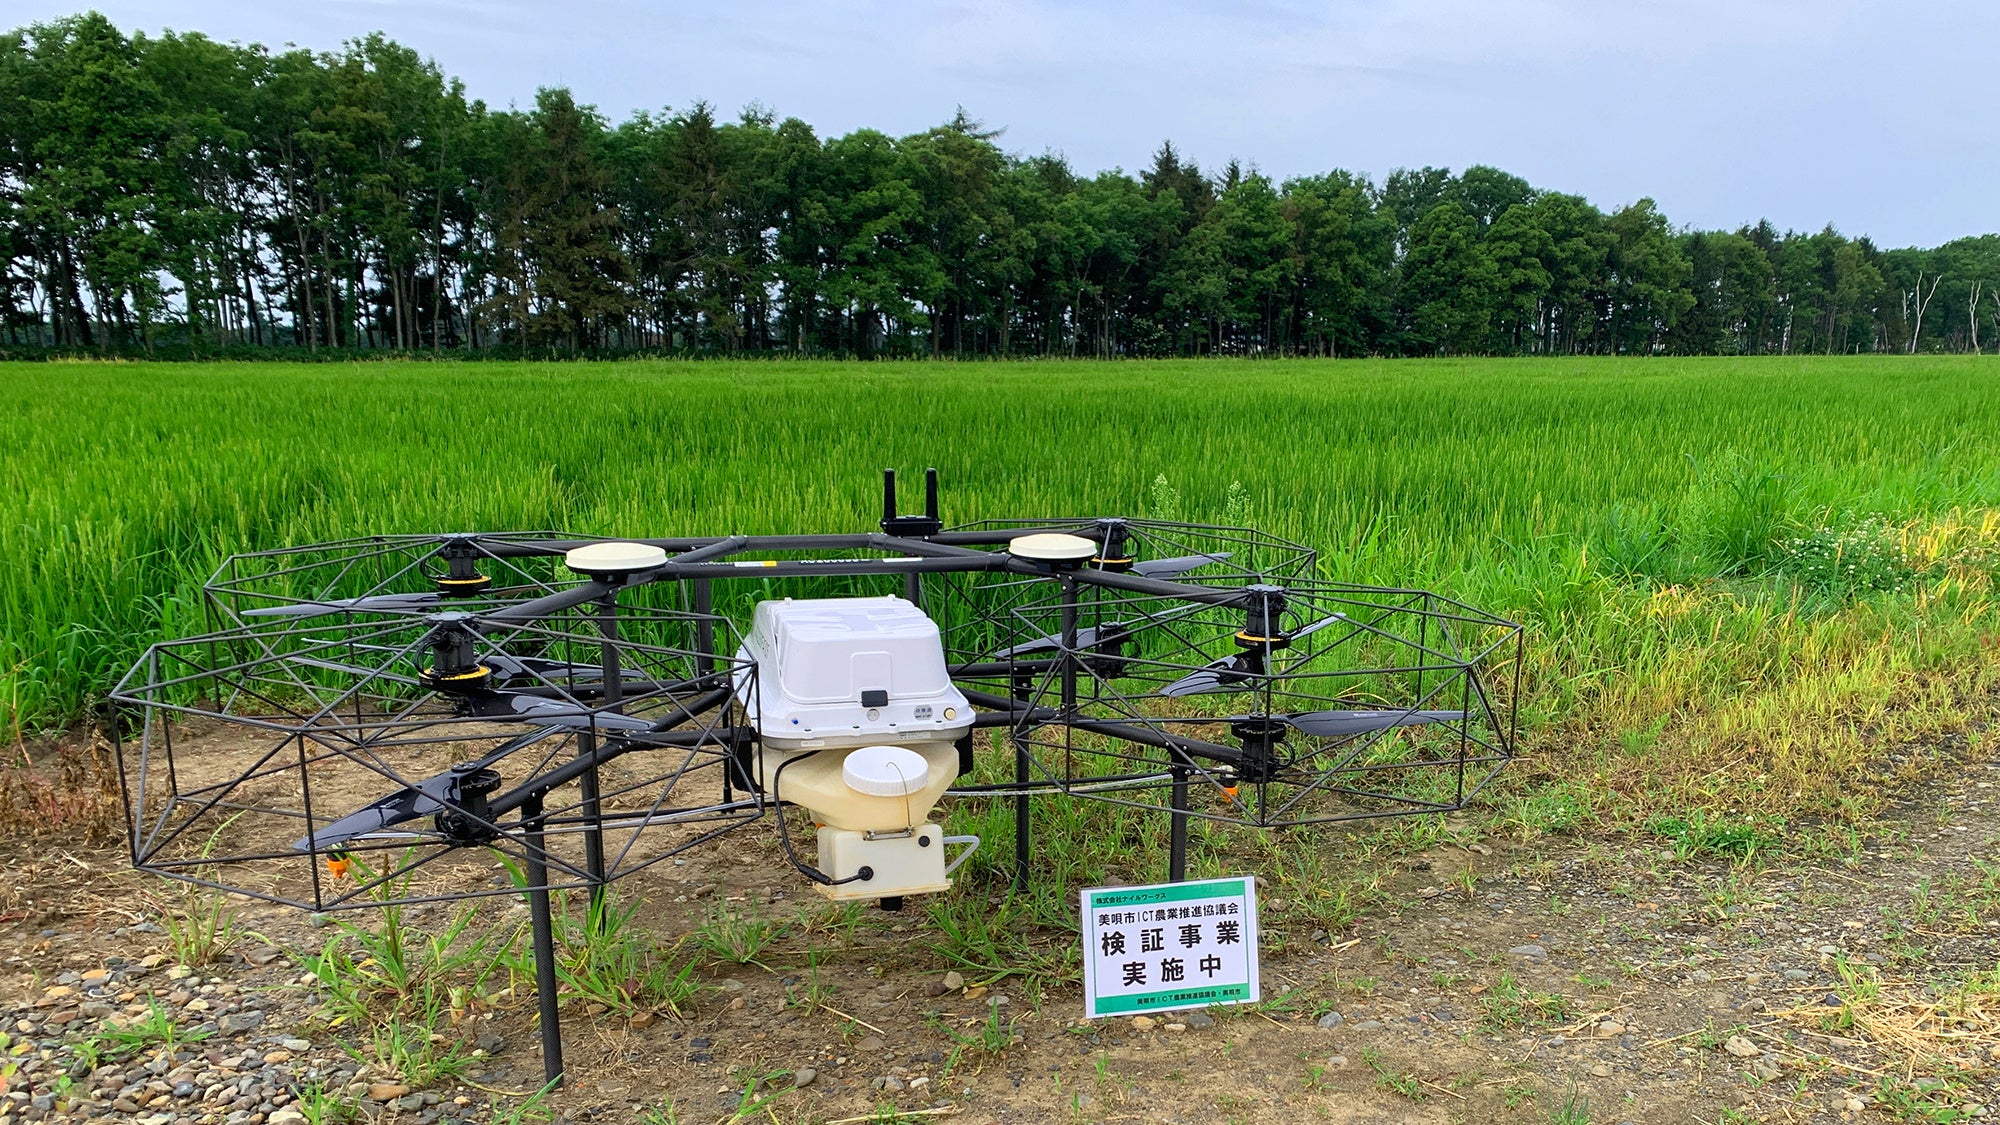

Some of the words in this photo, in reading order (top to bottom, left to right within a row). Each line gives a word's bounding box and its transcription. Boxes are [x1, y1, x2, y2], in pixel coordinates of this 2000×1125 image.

[1098, 902, 1239, 926] 美唄市ICT農業推進協議会
[1101, 920, 1240, 957] 検証事業
[1122, 954, 1222, 987] 実施中
